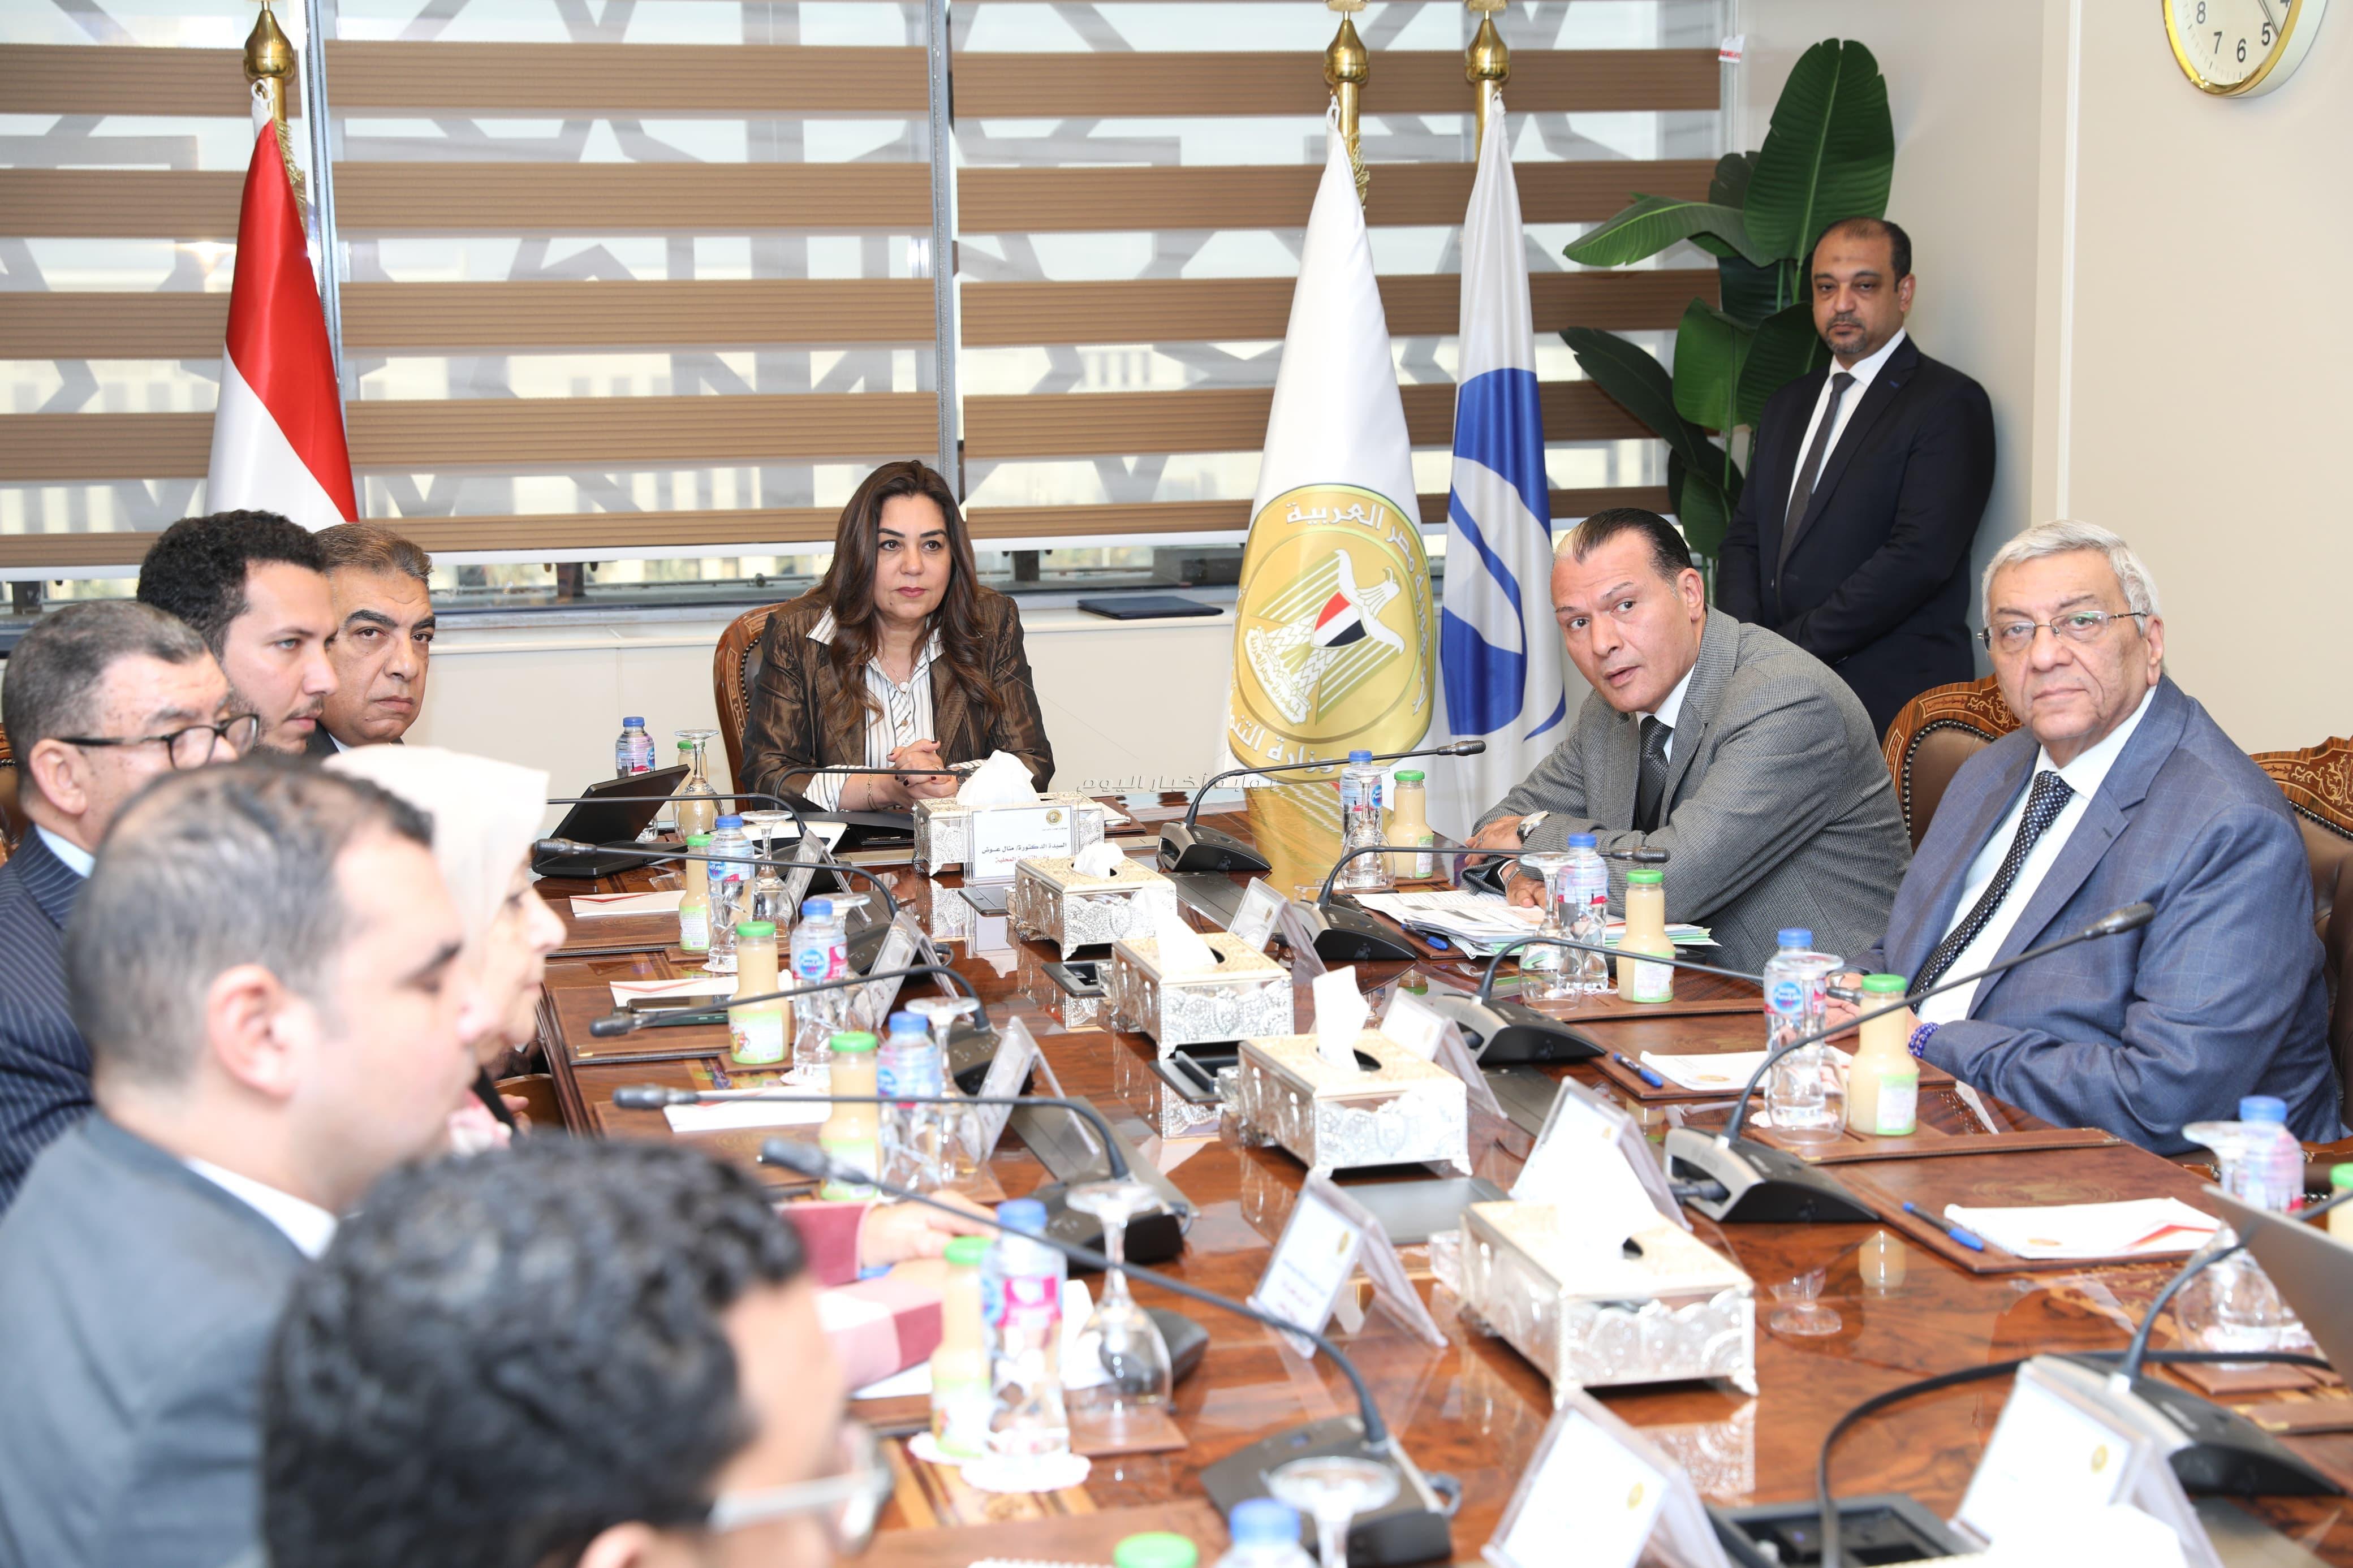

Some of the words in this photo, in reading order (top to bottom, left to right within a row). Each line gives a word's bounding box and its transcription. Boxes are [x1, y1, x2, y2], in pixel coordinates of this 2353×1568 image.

[2196, 1, 2207, 24] 8
[2213, 31, 2223, 55] 7
[2261, 22, 2271, 46] 5
[2236, 38, 2247, 63] 6
[1286, 502, 1385, 530] العربية
[1385, 525, 1415, 573] مصر
[1266, 736, 1335, 774] وزارة
